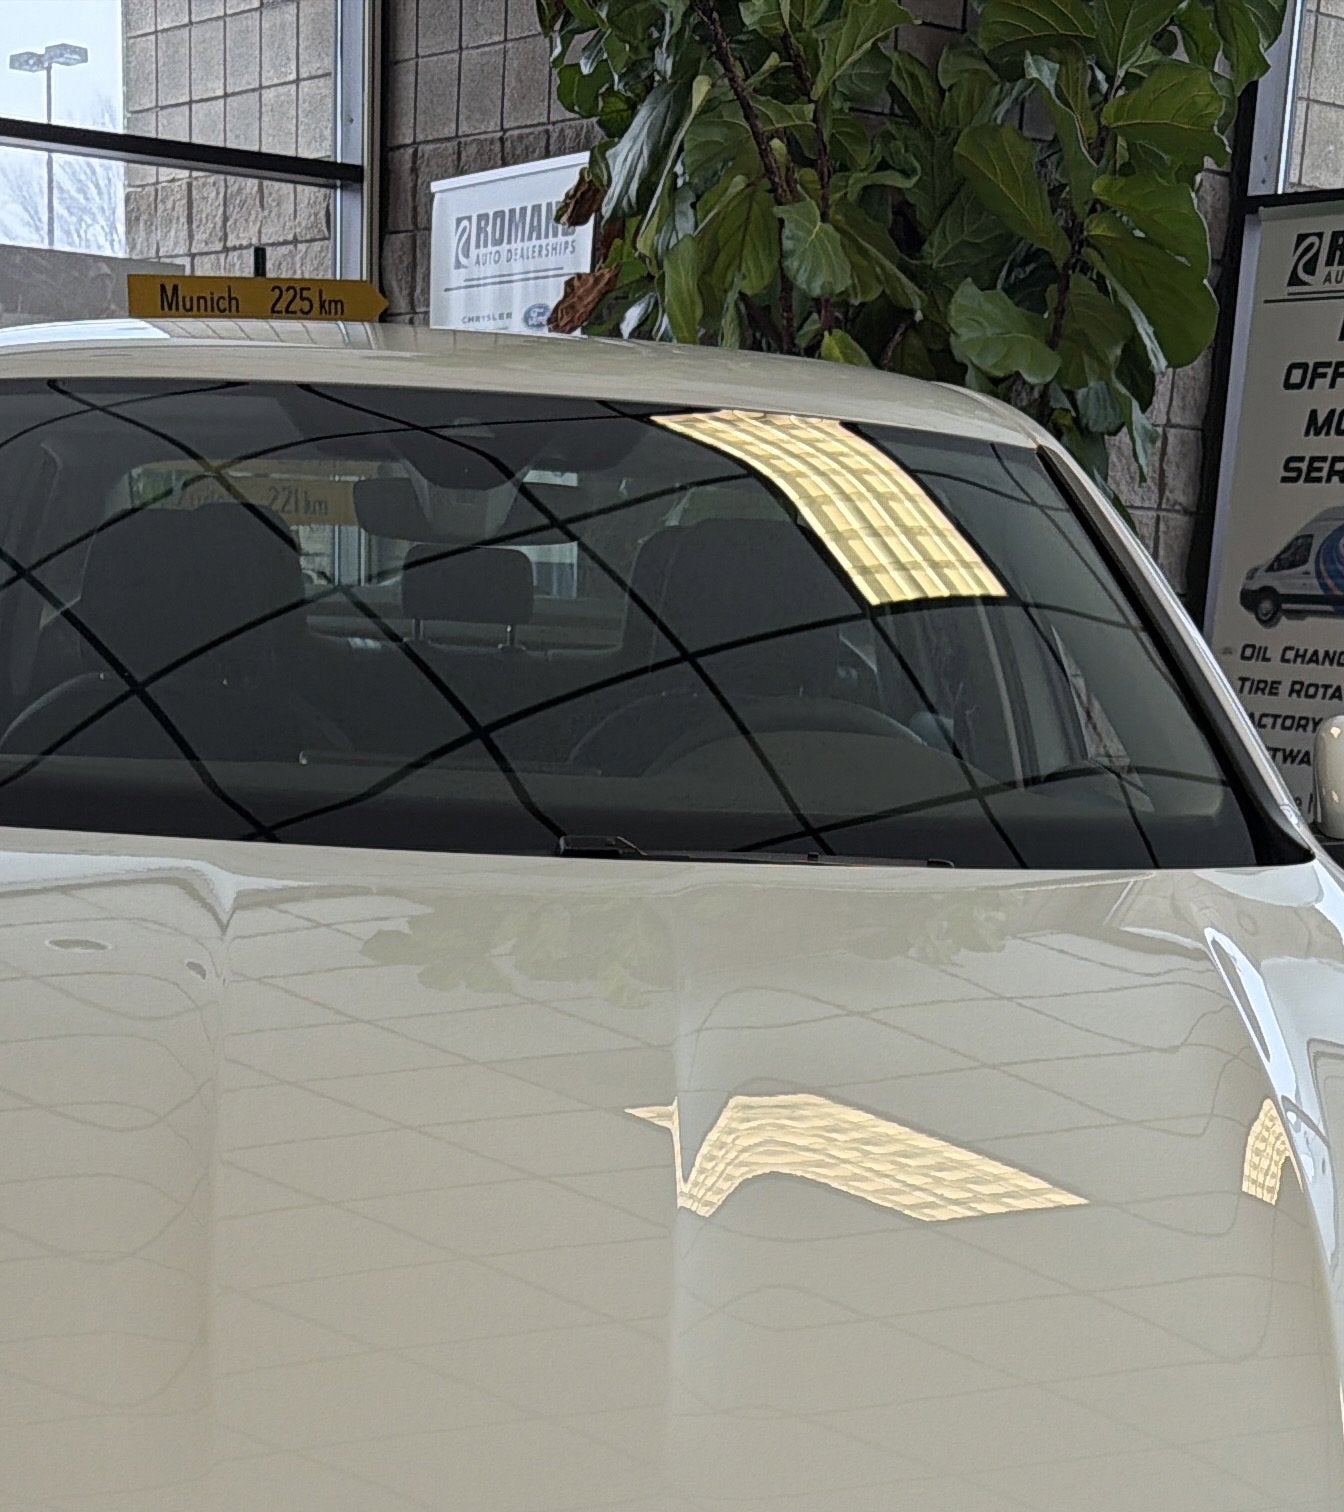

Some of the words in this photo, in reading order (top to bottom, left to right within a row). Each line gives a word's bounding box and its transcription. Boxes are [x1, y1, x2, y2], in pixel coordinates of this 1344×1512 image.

[475, 200, 576, 250] ROMAN
[475, 249, 502, 267] AUTO
[506, 239, 576, 263] DEALERSHIPS
[159, 283, 240, 314] Munich
[270, 285, 314, 316] 225
[319, 288, 345, 316] km
[1239, 643, 1271, 663] OIL
[1237, 676, 1283, 698] TIRE
[1249, 711, 1323, 734] ACTORY
